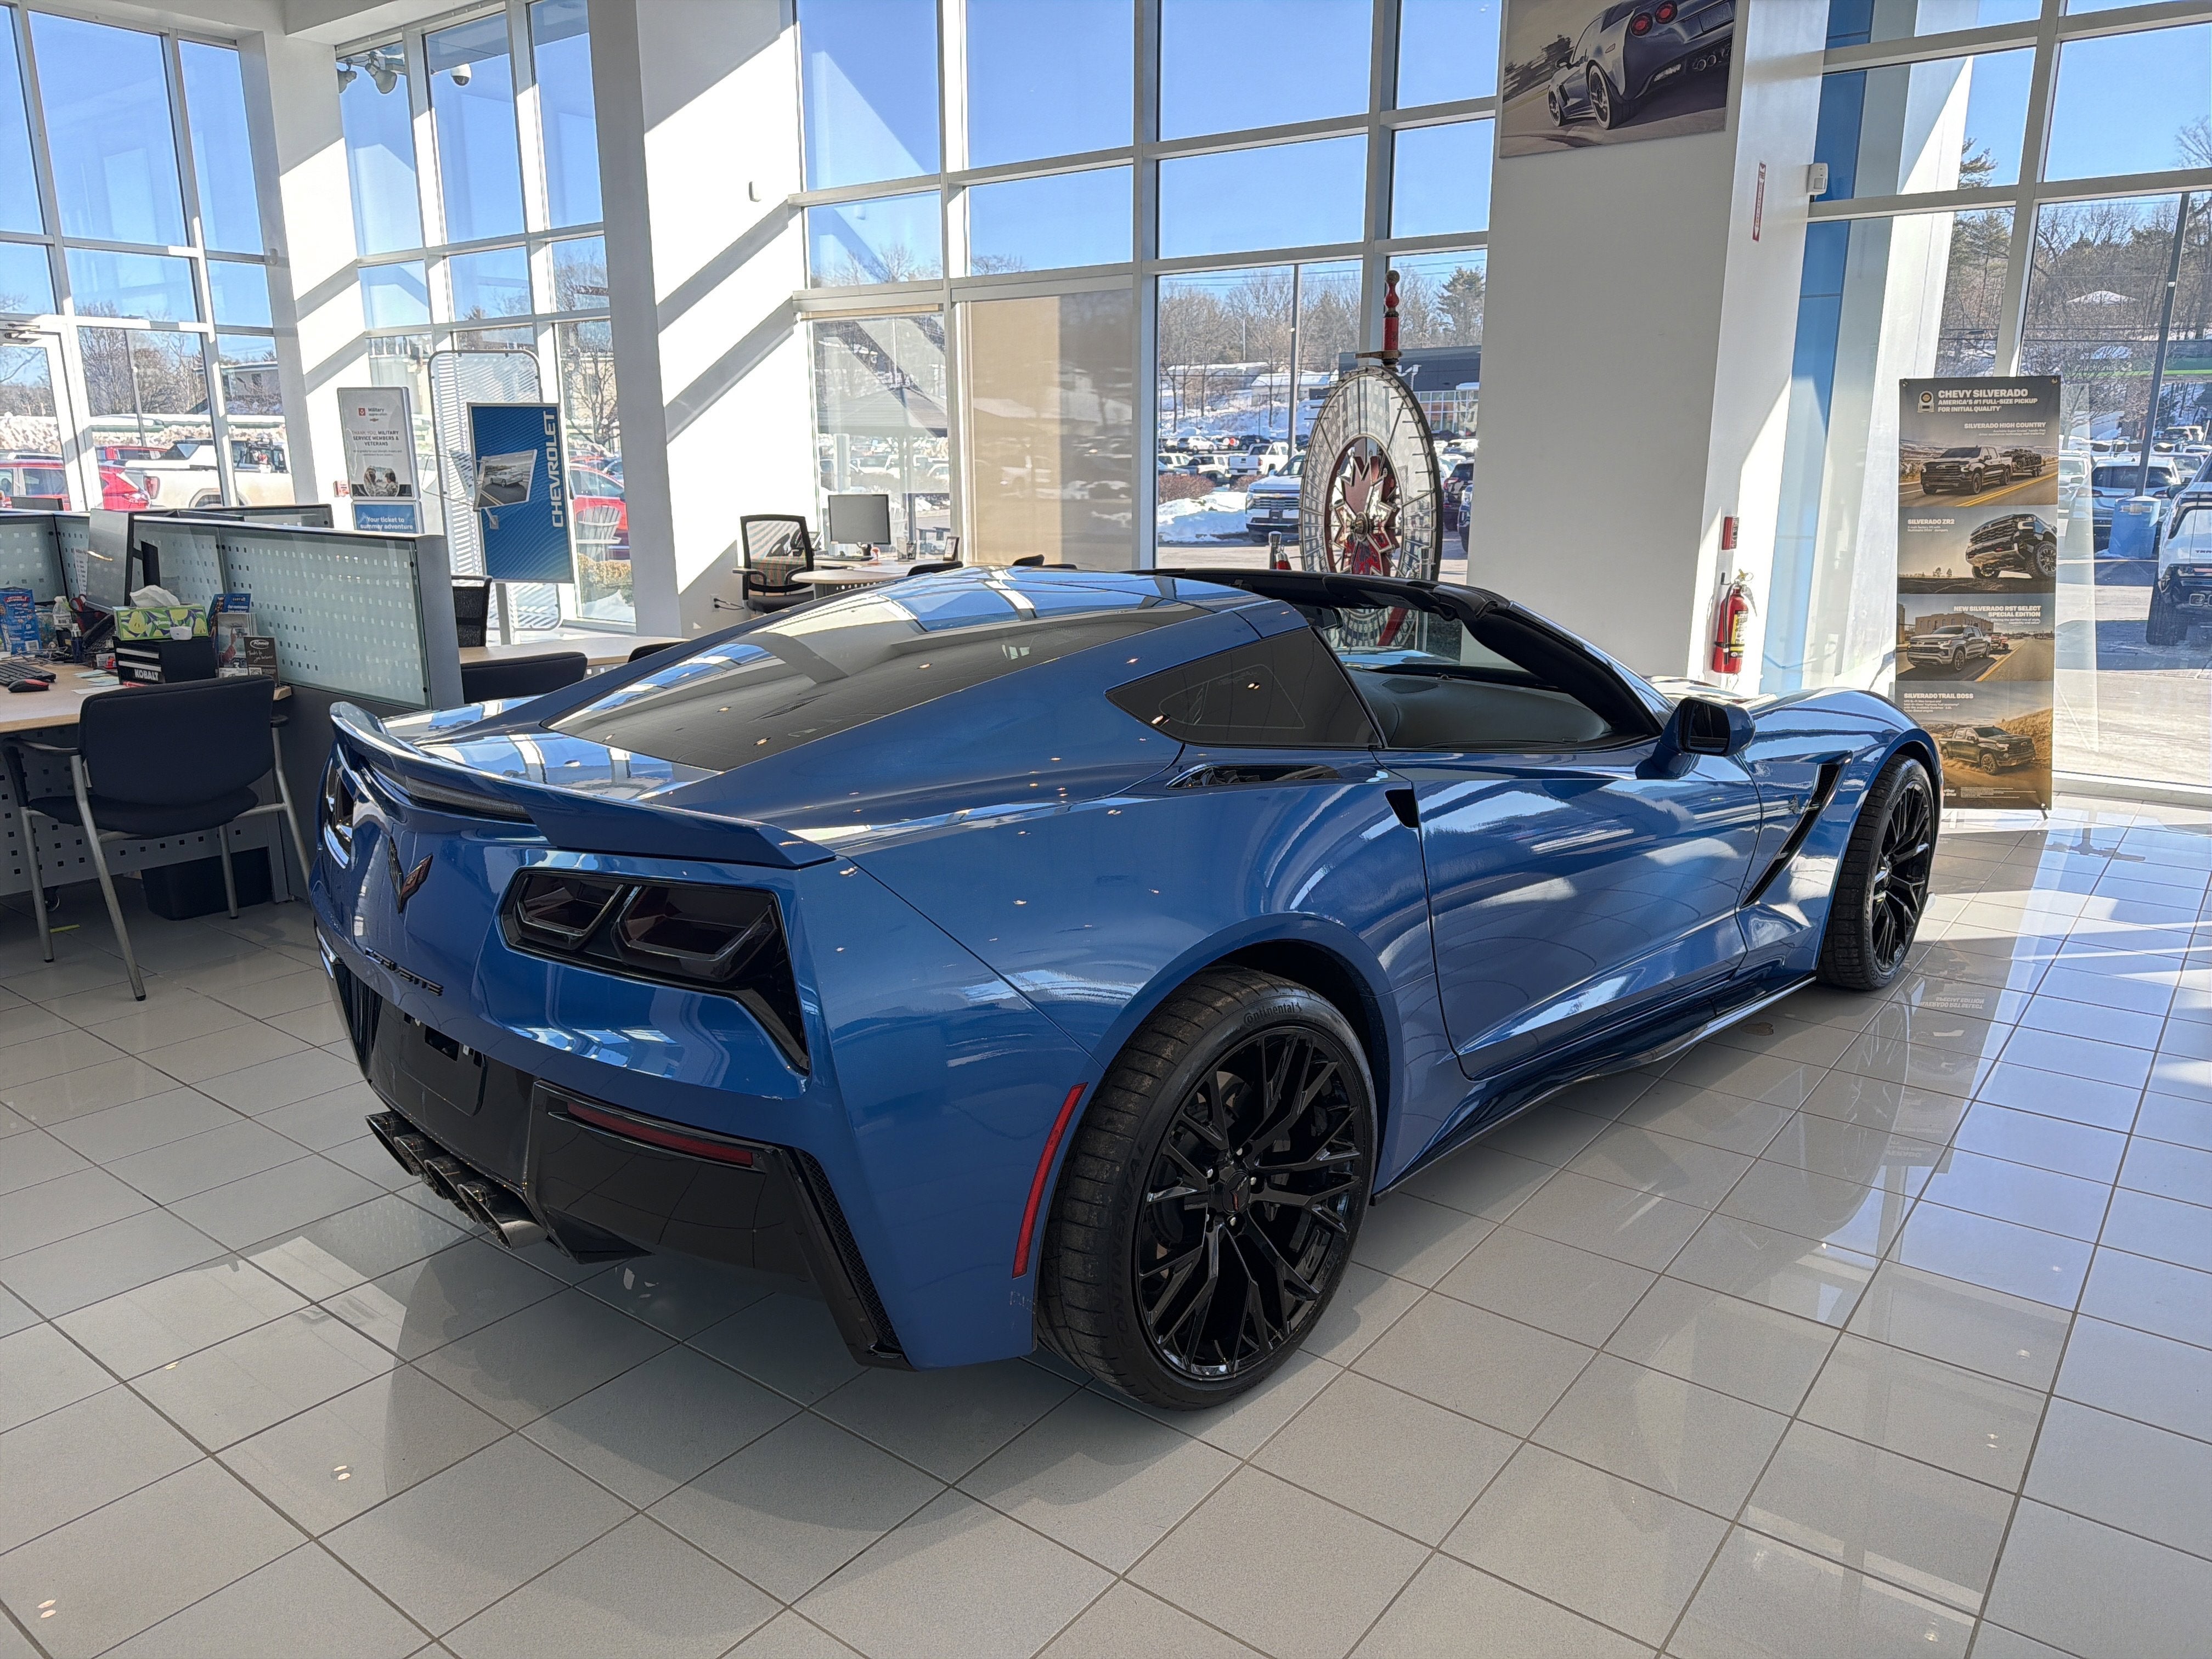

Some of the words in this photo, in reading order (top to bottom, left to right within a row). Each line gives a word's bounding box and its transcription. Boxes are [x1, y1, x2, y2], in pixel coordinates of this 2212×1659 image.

[1938, 390, 1972, 398] CHEVY
[1973, 388, 2029, 398] SILVERADO
[543, 410, 564, 527] CHEVROLET
[134, 669, 159, 681] KOBALT
[1244, 1002, 1295, 1026] Continental
